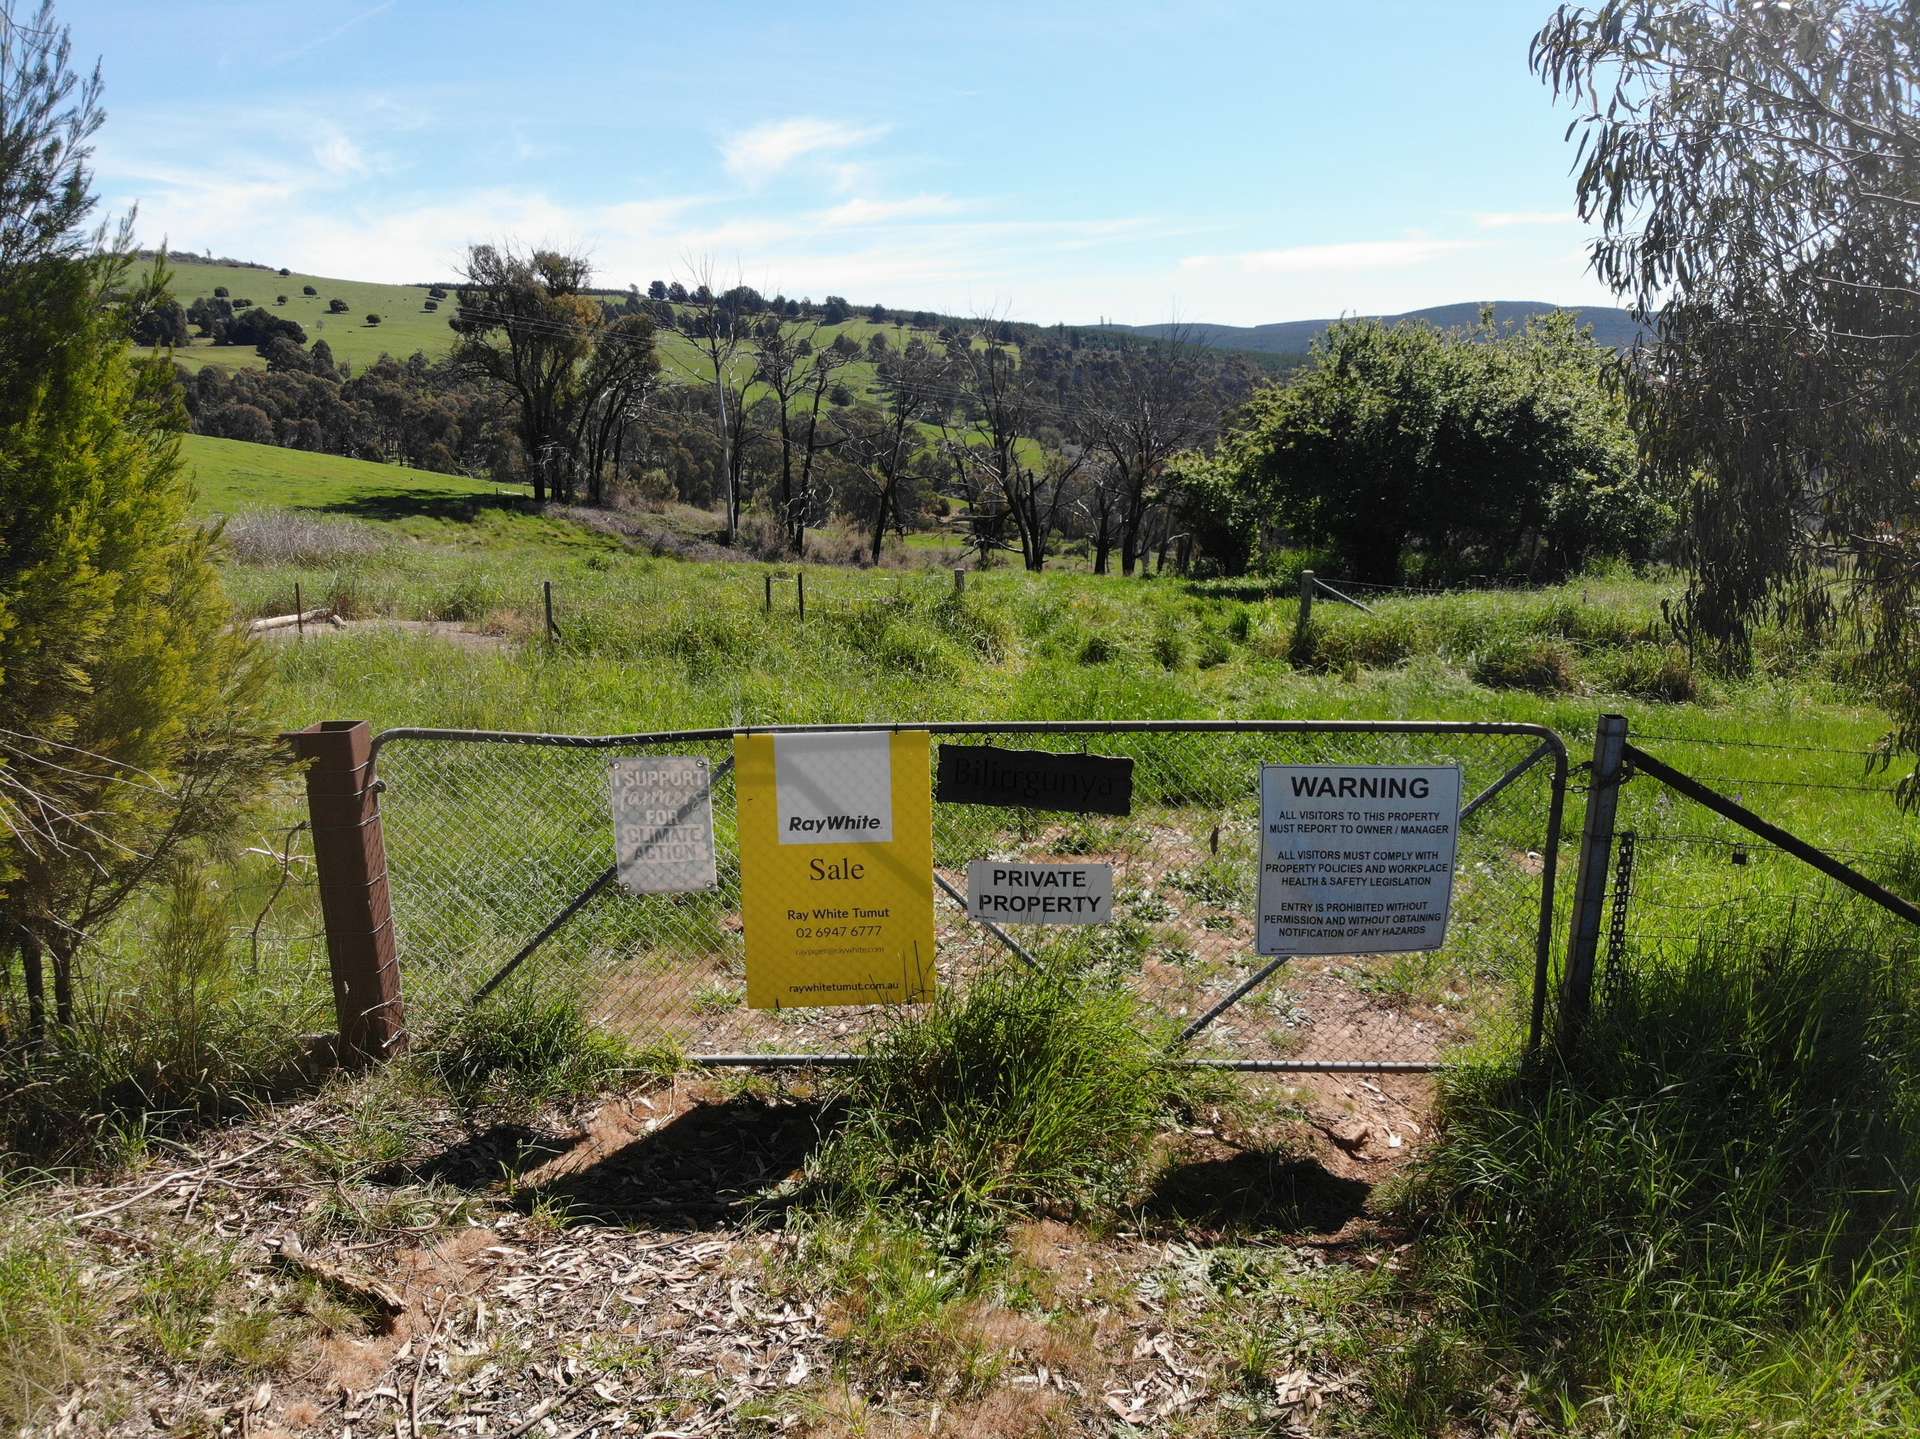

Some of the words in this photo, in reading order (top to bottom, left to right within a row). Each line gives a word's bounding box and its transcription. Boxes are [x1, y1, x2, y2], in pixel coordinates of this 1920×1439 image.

[614, 770, 620, 787] I
[624, 770, 705, 787] SUPPORT
[1291, 776, 1429, 799] WARNING
[645, 809, 678, 825] FOR
[1279, 811, 1296, 820] ALL
[1300, 811, 1344, 821] VISITORS
[1347, 812, 1360, 821] TO
[1363, 812, 1385, 821] THIS
[1388, 812, 1440, 821] PROPERTY
[626, 826, 702, 844] CLIMATE
[1269, 824, 1295, 833] MUST
[1297, 824, 1337, 833] REPORT
[1340, 825, 1353, 834] TO
[1356, 825, 1393, 834] OWNER
[1394, 826, 1399, 834] /
[1400, 825, 1449, 834] MANAGER
[635, 844, 696, 860] ACTION
[1278, 850, 1295, 860] ALL
[1297, 850, 1341, 860] VISITORS
[1343, 851, 1371, 860] MUST
[1373, 851, 1413, 861] COMPLY
[1415, 851, 1439, 860] WITH
[809, 857, 864, 880] Sale
[1265, 863, 1316, 873] PROPERTY
[1318, 863, 1363, 873] POLICIES
[1365, 864, 1386, 873] AND
[1388, 864, 1448, 873] WORKPLACE
[993, 869, 1086, 887] PRIVATE
[1281, 877, 1318, 886] HEALTH
[1321, 876, 1327, 886] &
[1329, 877, 1367, 886] SAFETY
[1370, 877, 1431, 886] LEGISLATION
[979, 895, 1102, 912] PROPERTY
[1281, 902, 1313, 912] ENTRY
[1315, 903, 1324, 912] IS
[1326, 903, 1384, 912] PROHIBITED
[1386, 902, 1428, 912] WITHOUT
[787, 909, 809, 921] Ray
[813, 908, 849, 919] White
[852, 907, 890, 918] Tumut
[1264, 914, 1323, 925] PERMISSION
[1325, 916, 1346, 925] AND
[1348, 915, 1391, 925] WITHOUT
[1392, 912, 1441, 923] OBTAINING
[796, 927, 812, 938] 02
[815, 926, 847, 938] 6947
[850, 925, 882, 937] 6777
[1279, 928, 1345, 938] NOTIFICATION
[1346, 928, 1359, 937] OF
[1361, 928, 1380, 937] ANY
[1382, 925, 1426, 936] HAZARDS
[789, 982, 899, 994] raywhitetumut.com.au
